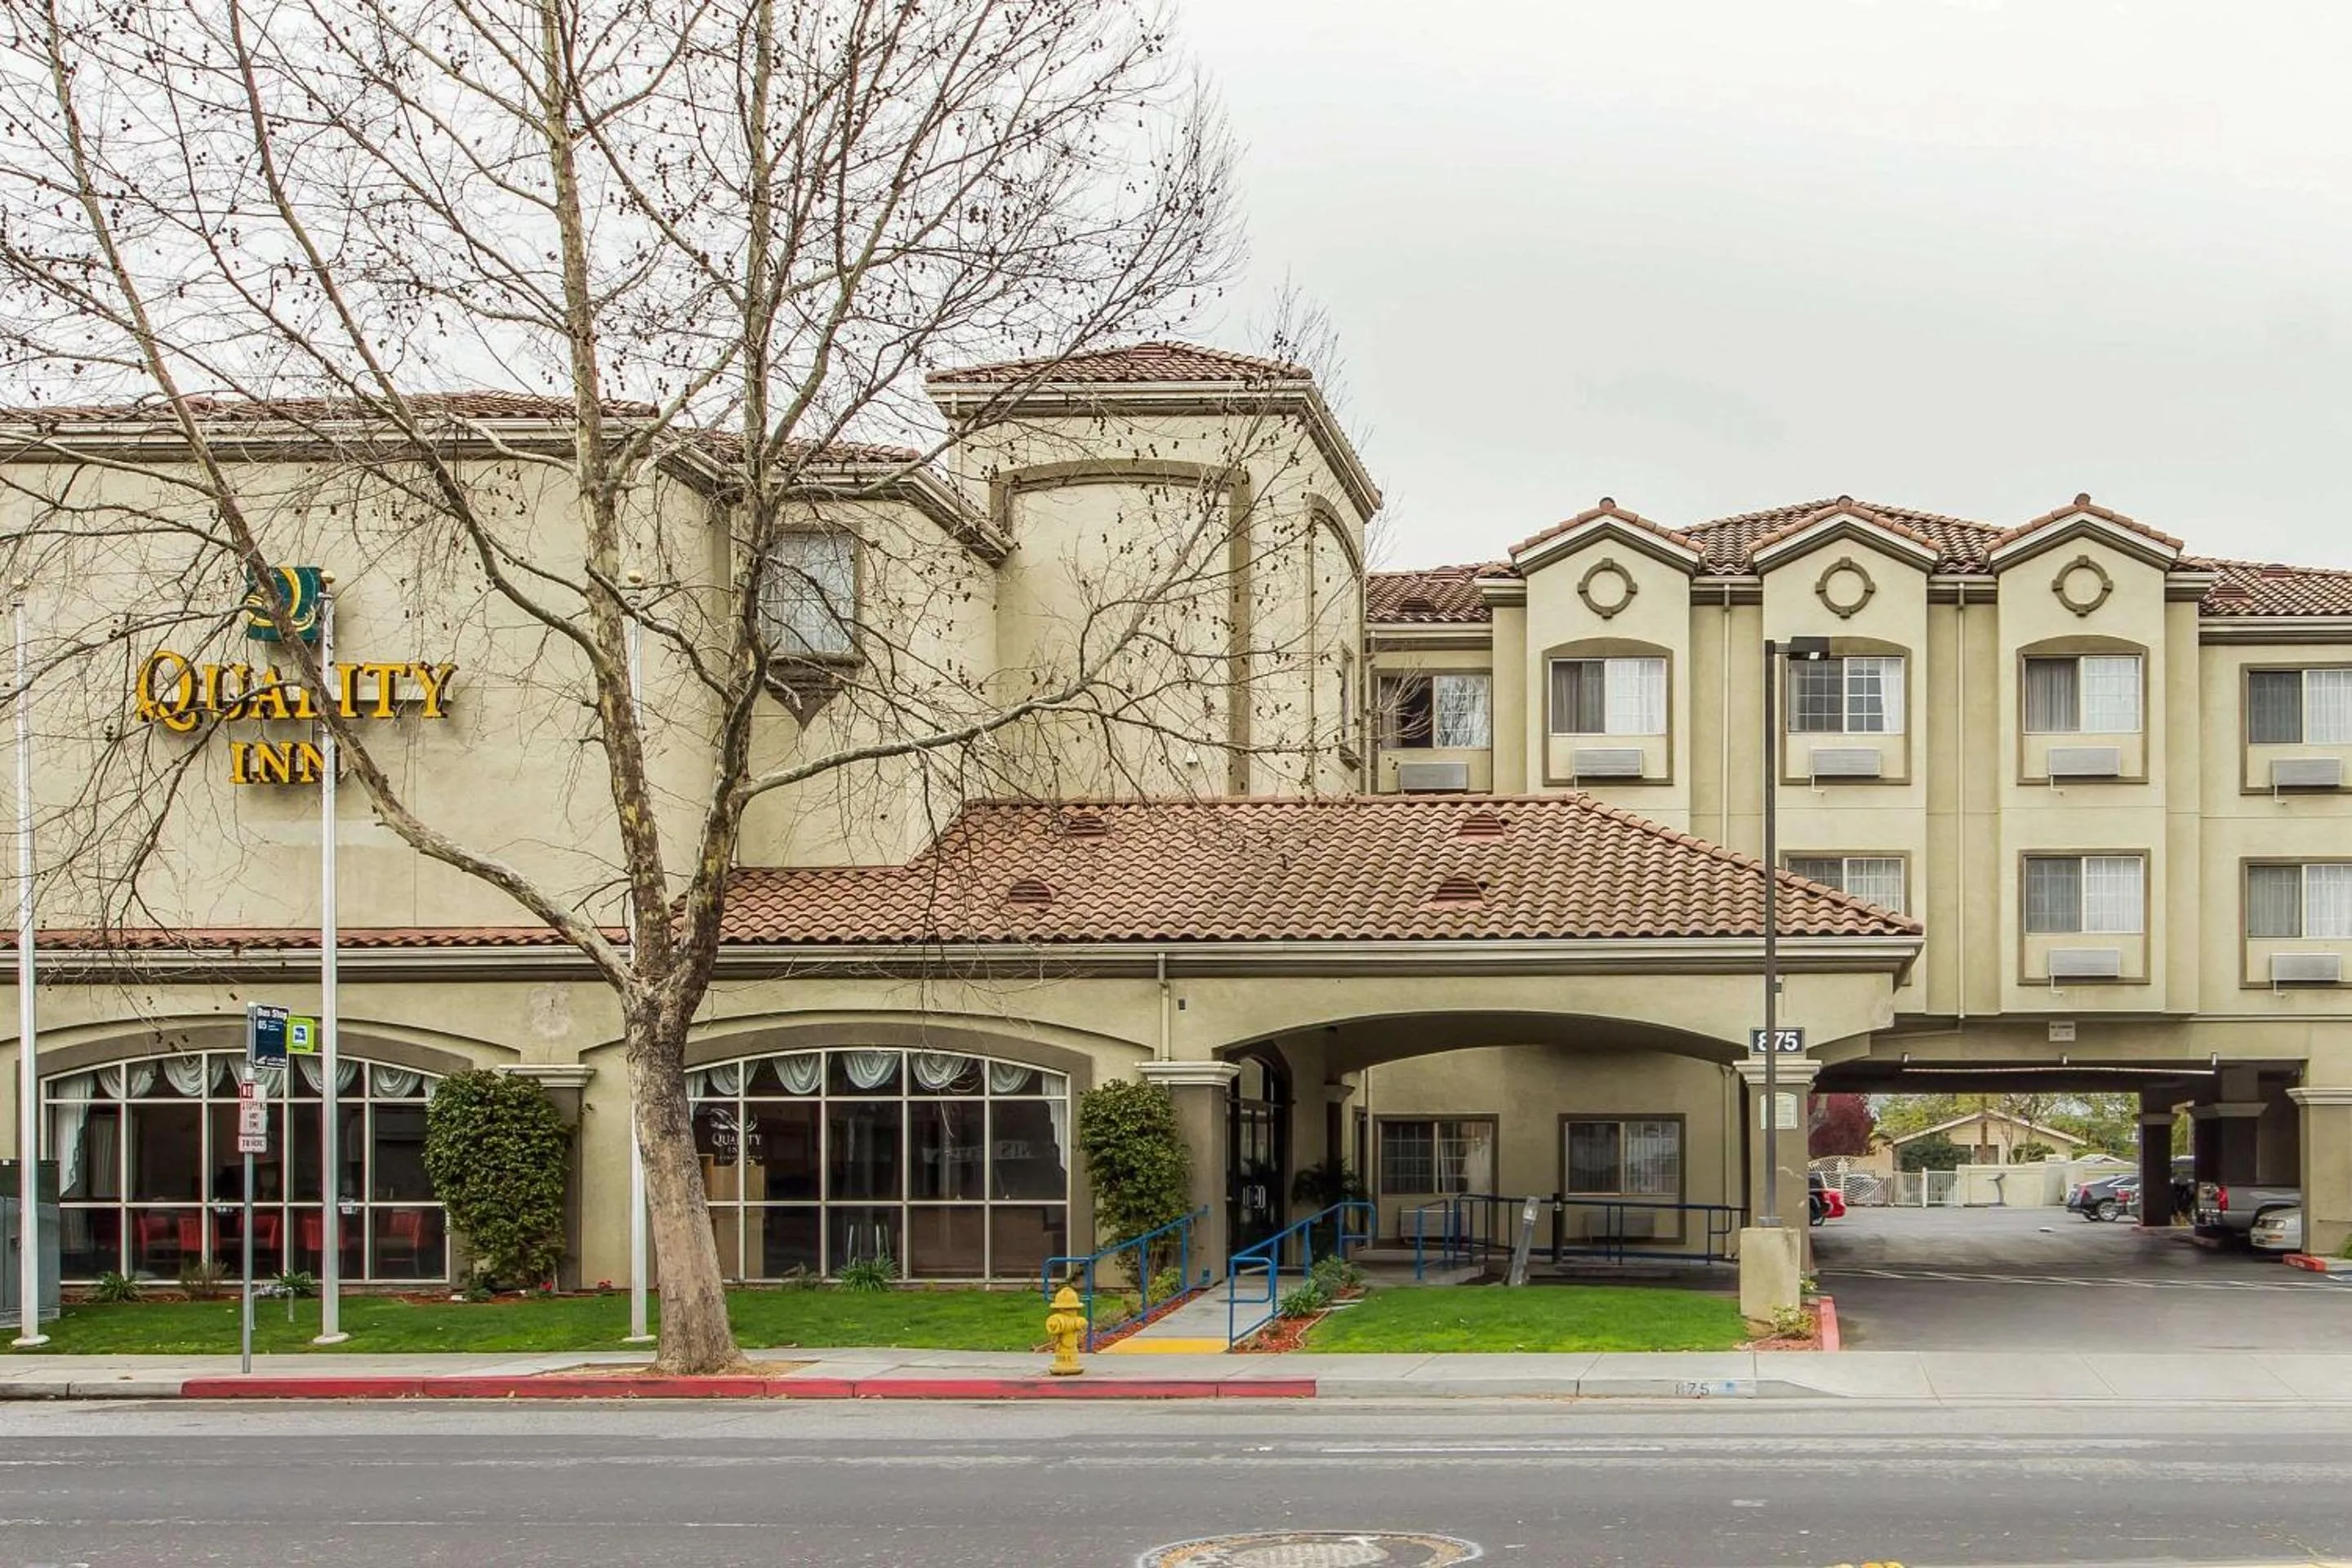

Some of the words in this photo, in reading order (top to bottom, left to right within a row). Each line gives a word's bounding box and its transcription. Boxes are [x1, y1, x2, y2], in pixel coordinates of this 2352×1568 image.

[229, 741, 339, 785] INN
[1757, 1031, 1798, 1052] 875
[712, 1133, 761, 1147] QUATY
